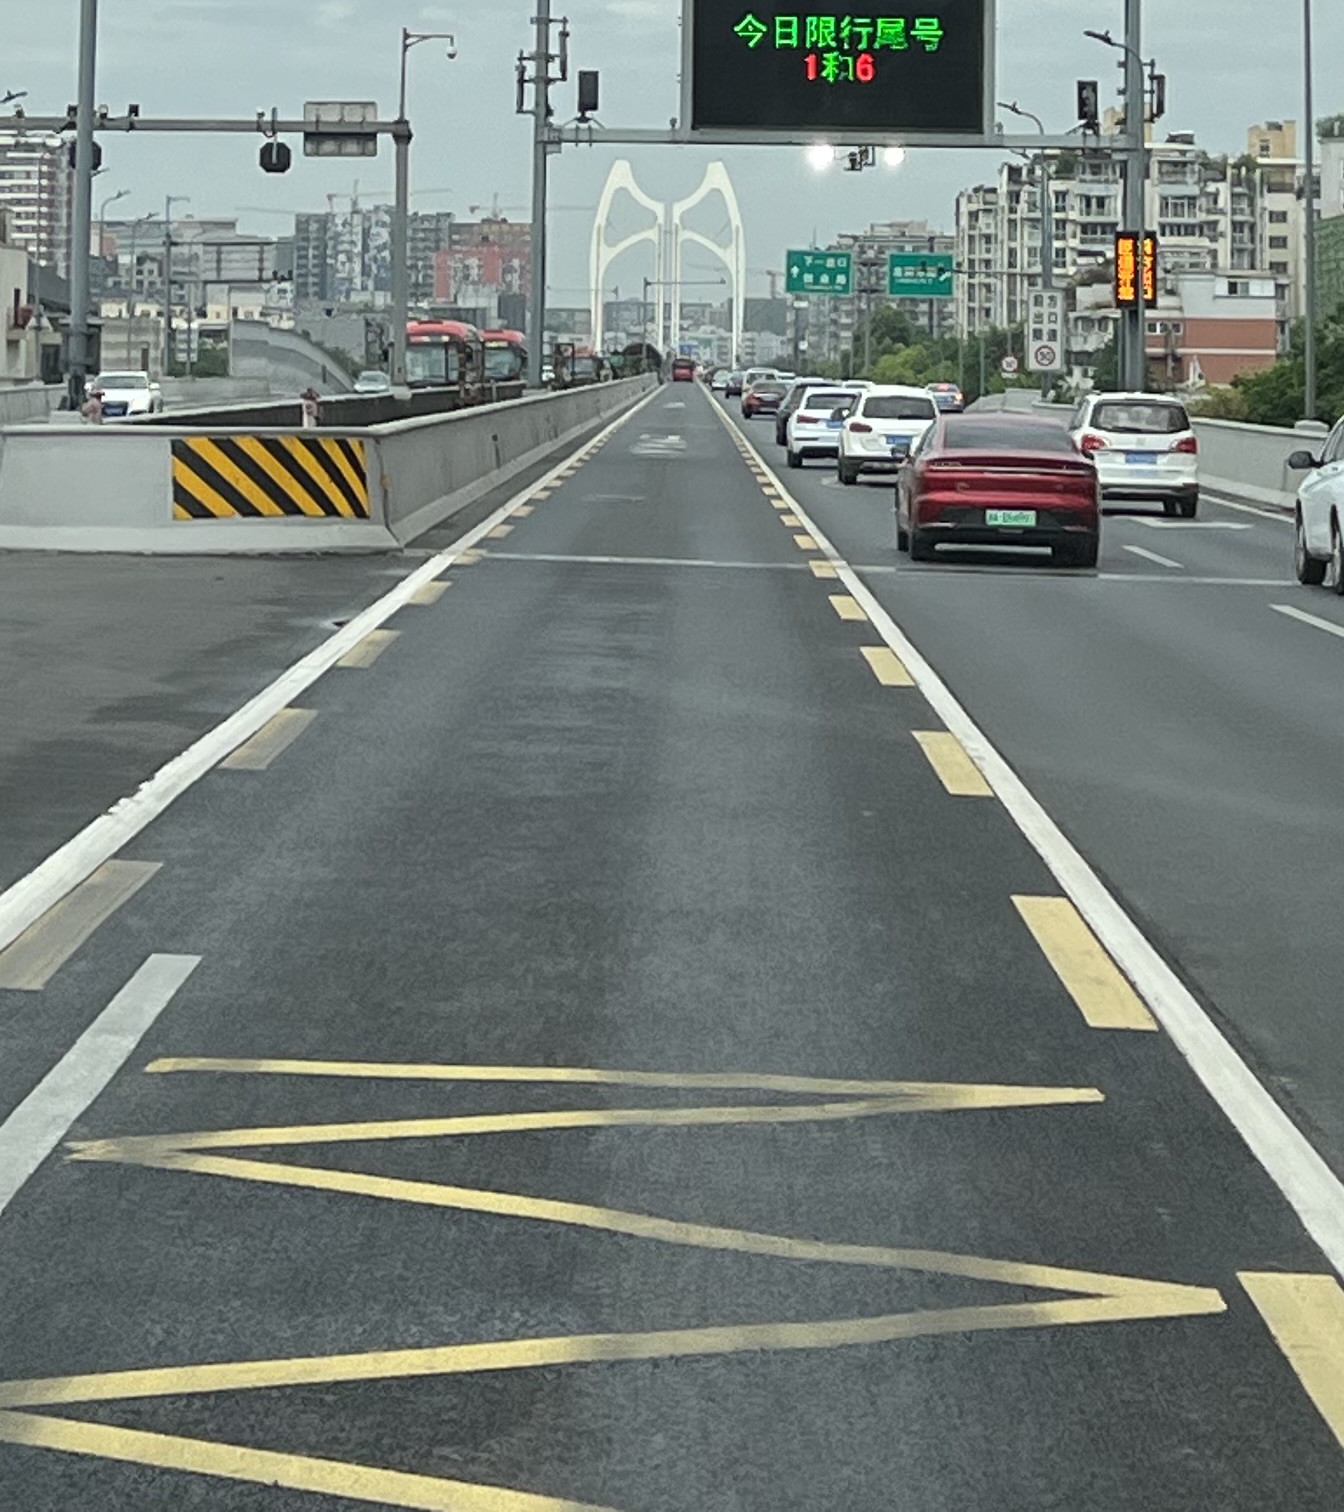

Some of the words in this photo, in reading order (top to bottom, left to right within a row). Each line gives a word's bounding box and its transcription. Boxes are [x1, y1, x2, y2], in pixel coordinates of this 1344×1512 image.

[733, 13, 944, 51] 今日限行尾号
[804, 51, 876, 83] 1和6
